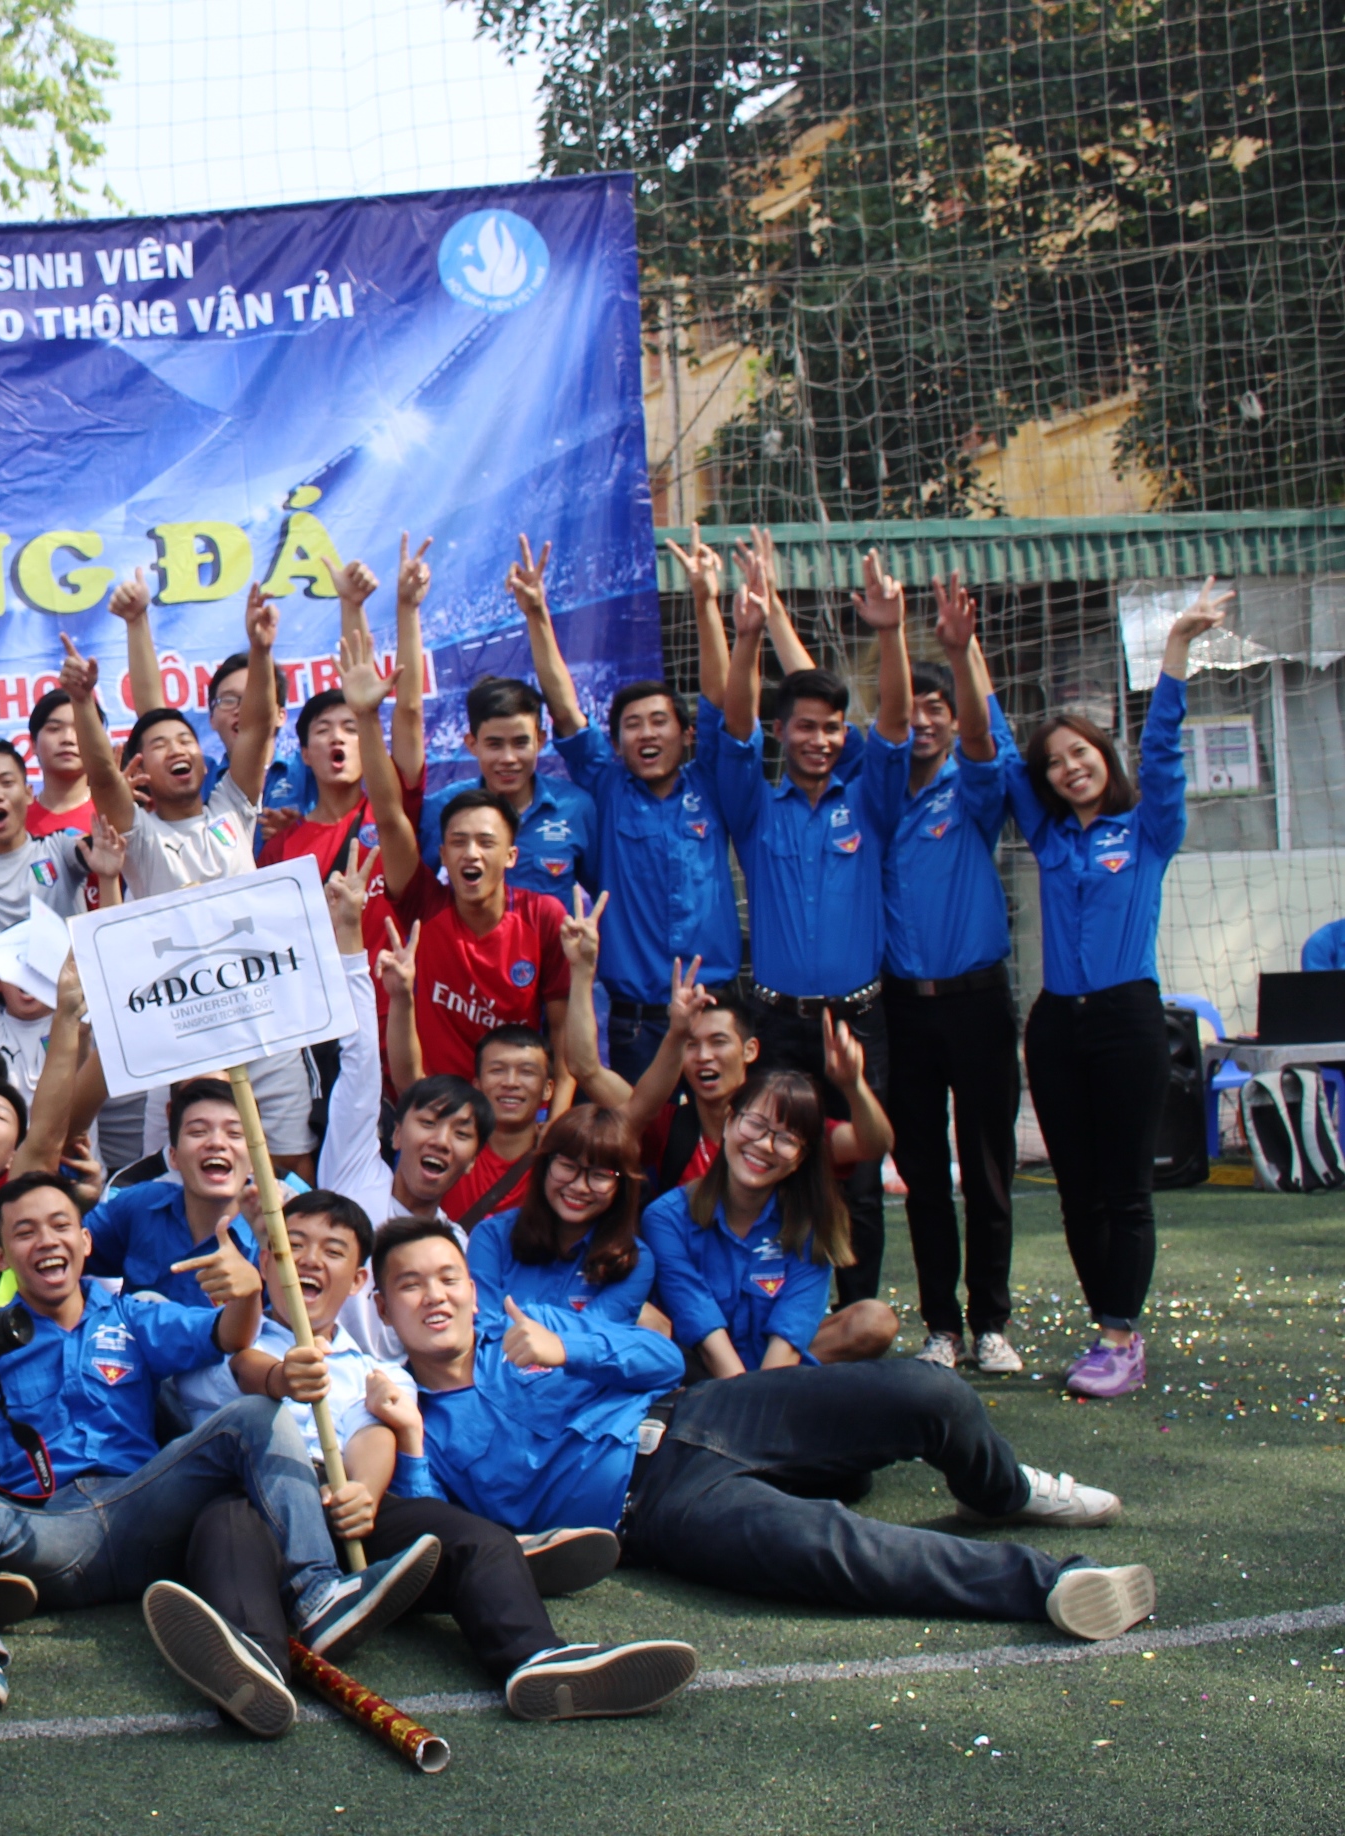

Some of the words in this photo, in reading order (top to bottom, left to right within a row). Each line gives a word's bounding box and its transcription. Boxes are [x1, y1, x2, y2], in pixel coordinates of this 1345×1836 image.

[95, 237, 195, 286] VIÊN
[36, 293, 178, 341] THÔNG
[187, 285, 275, 339] VẬN
[283, 268, 356, 322] TẢI
[148, 485, 345, 606] ĐÁ
[128, 946, 302, 1014] 64DCCD11
[170, 991, 250, 1020] UNIVERSITY
[254, 984, 271, 999] OF
[174, 1011, 218, 1032] TRANSPORT
[218, 999, 274, 1020] TECHNOLOGY
